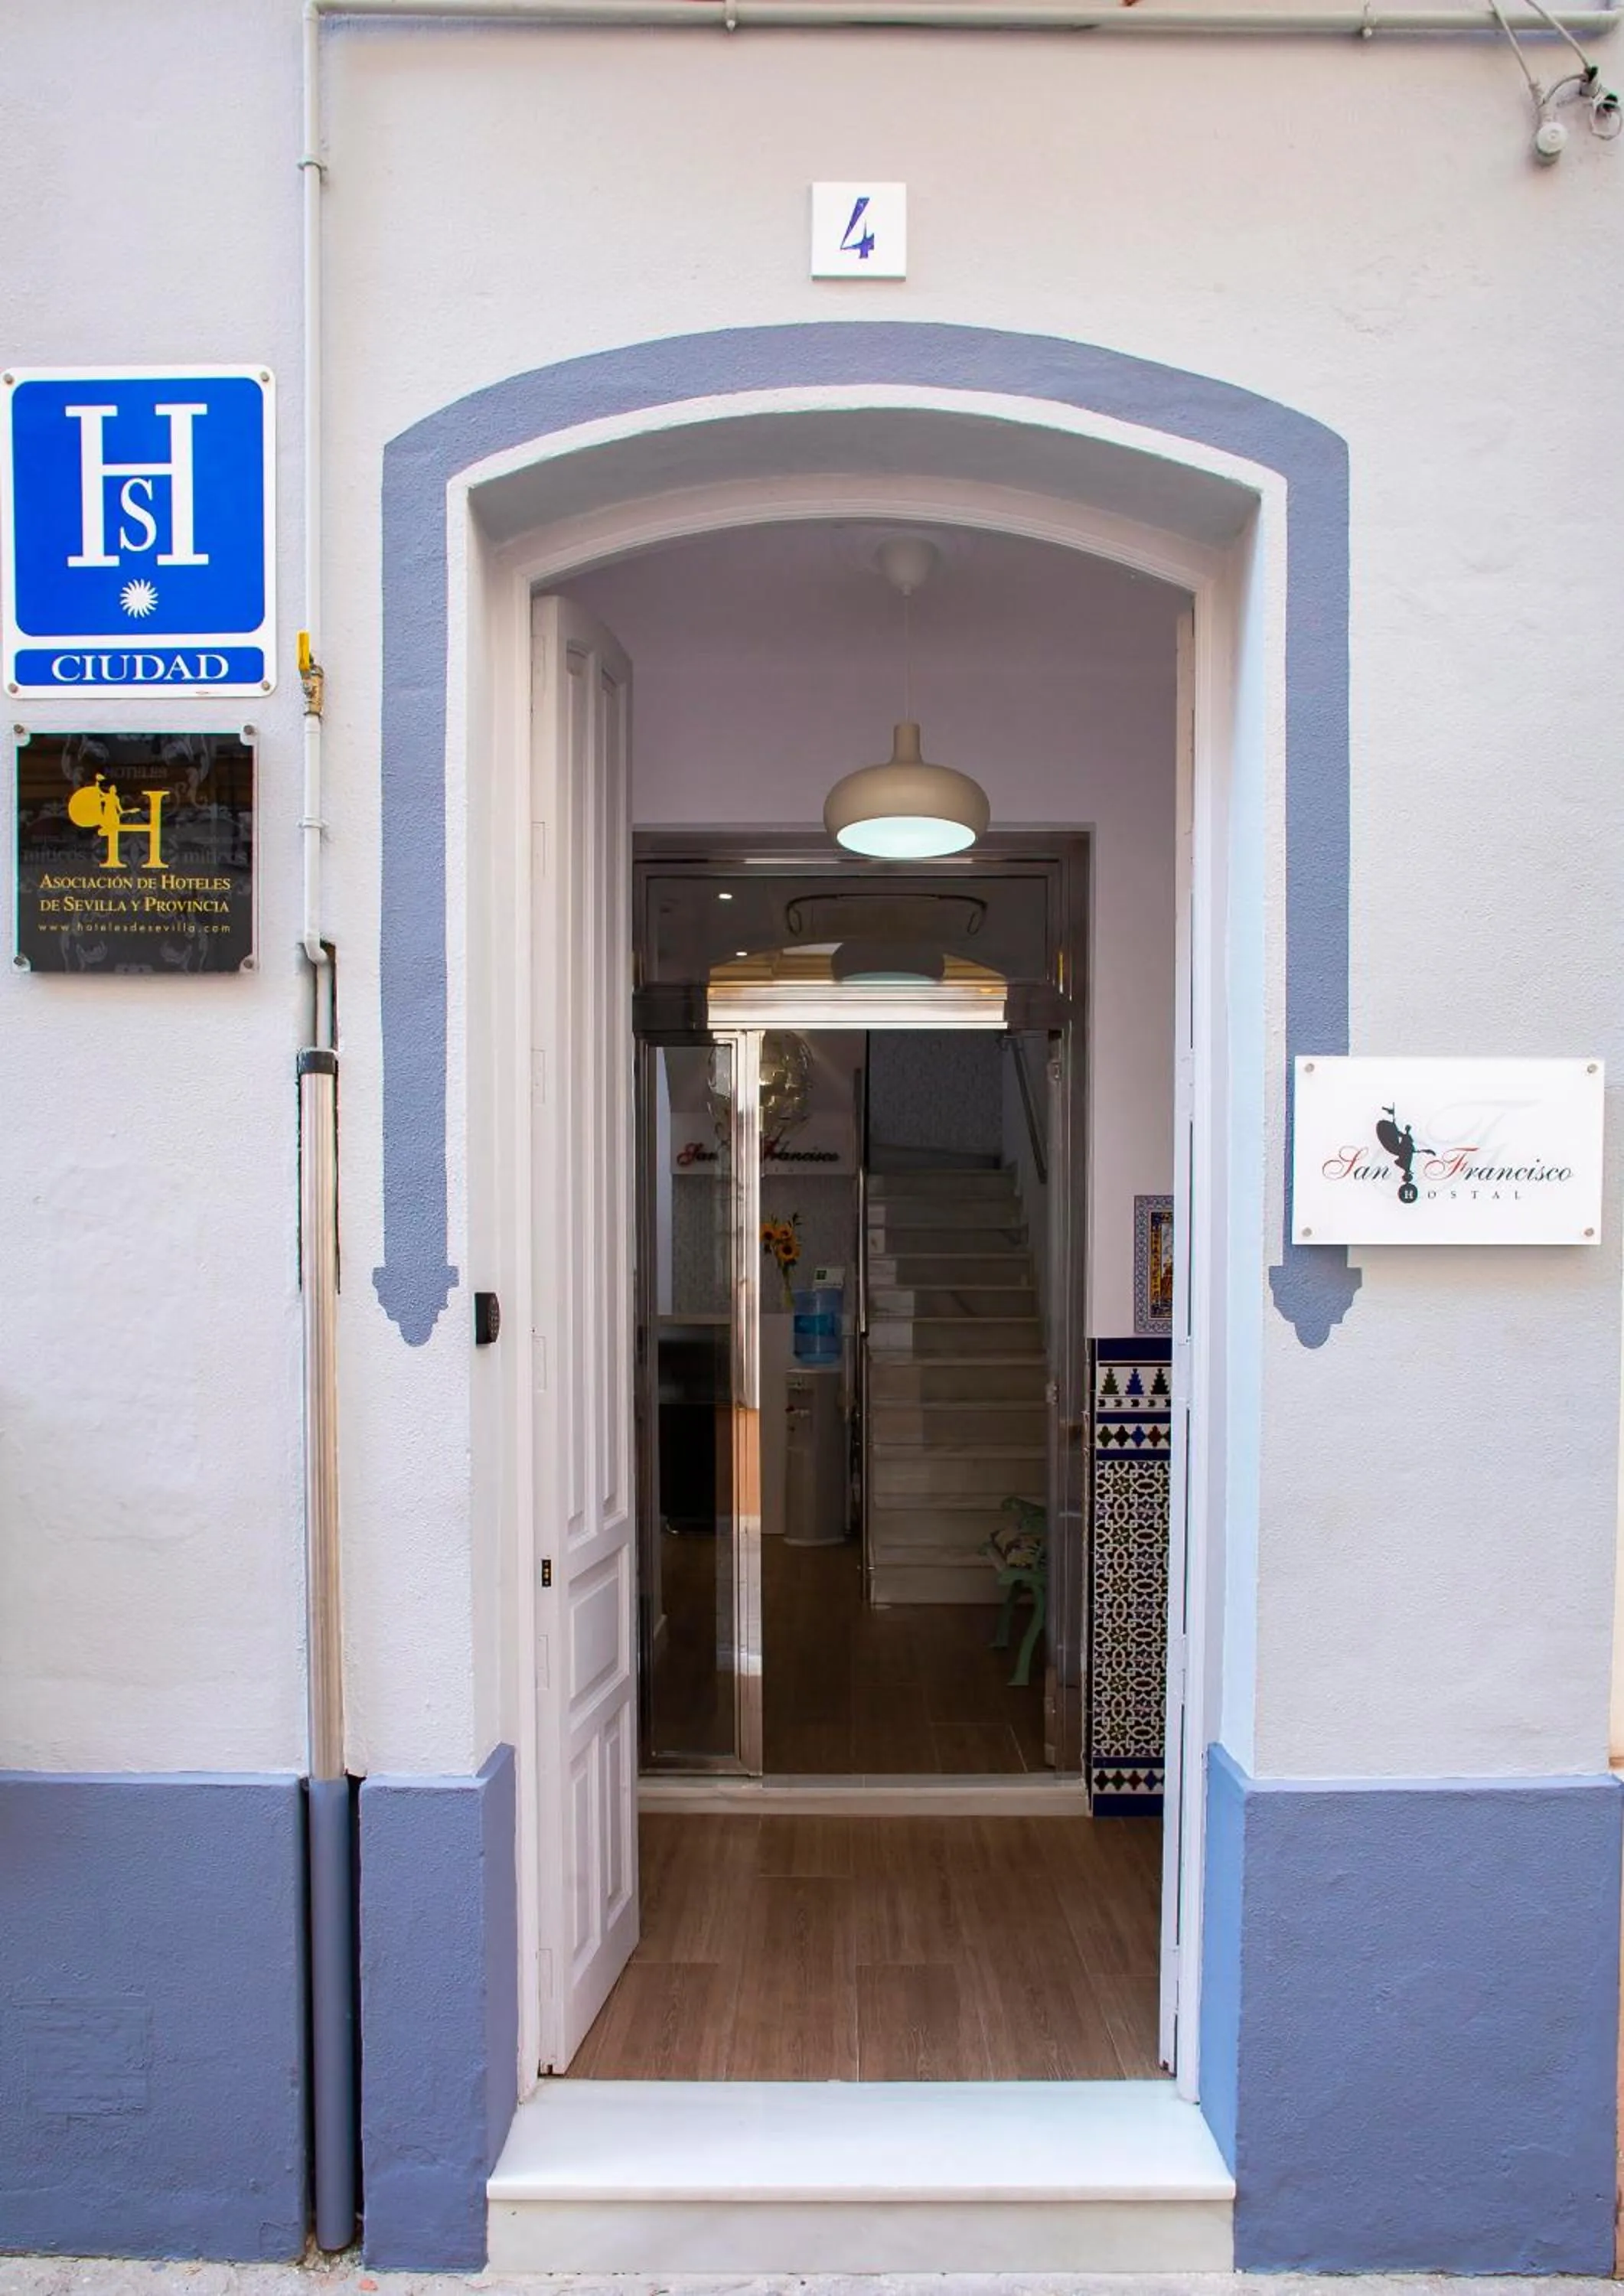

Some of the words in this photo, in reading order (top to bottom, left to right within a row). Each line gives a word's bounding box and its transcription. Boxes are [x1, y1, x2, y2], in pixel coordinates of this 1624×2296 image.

[840, 197, 874, 259] 4
[51, 654, 229, 681] CIUDAD
[161, 874, 230, 890] HOTELES
[64, 896, 126, 912] SEVILLA
[145, 896, 230, 913] PROVINCIA
[38, 921, 230, 933] www.hotelesdesevilla.com
[1322, 1145, 1391, 1181] San
[1424, 1147, 1573, 1182] Francisco
